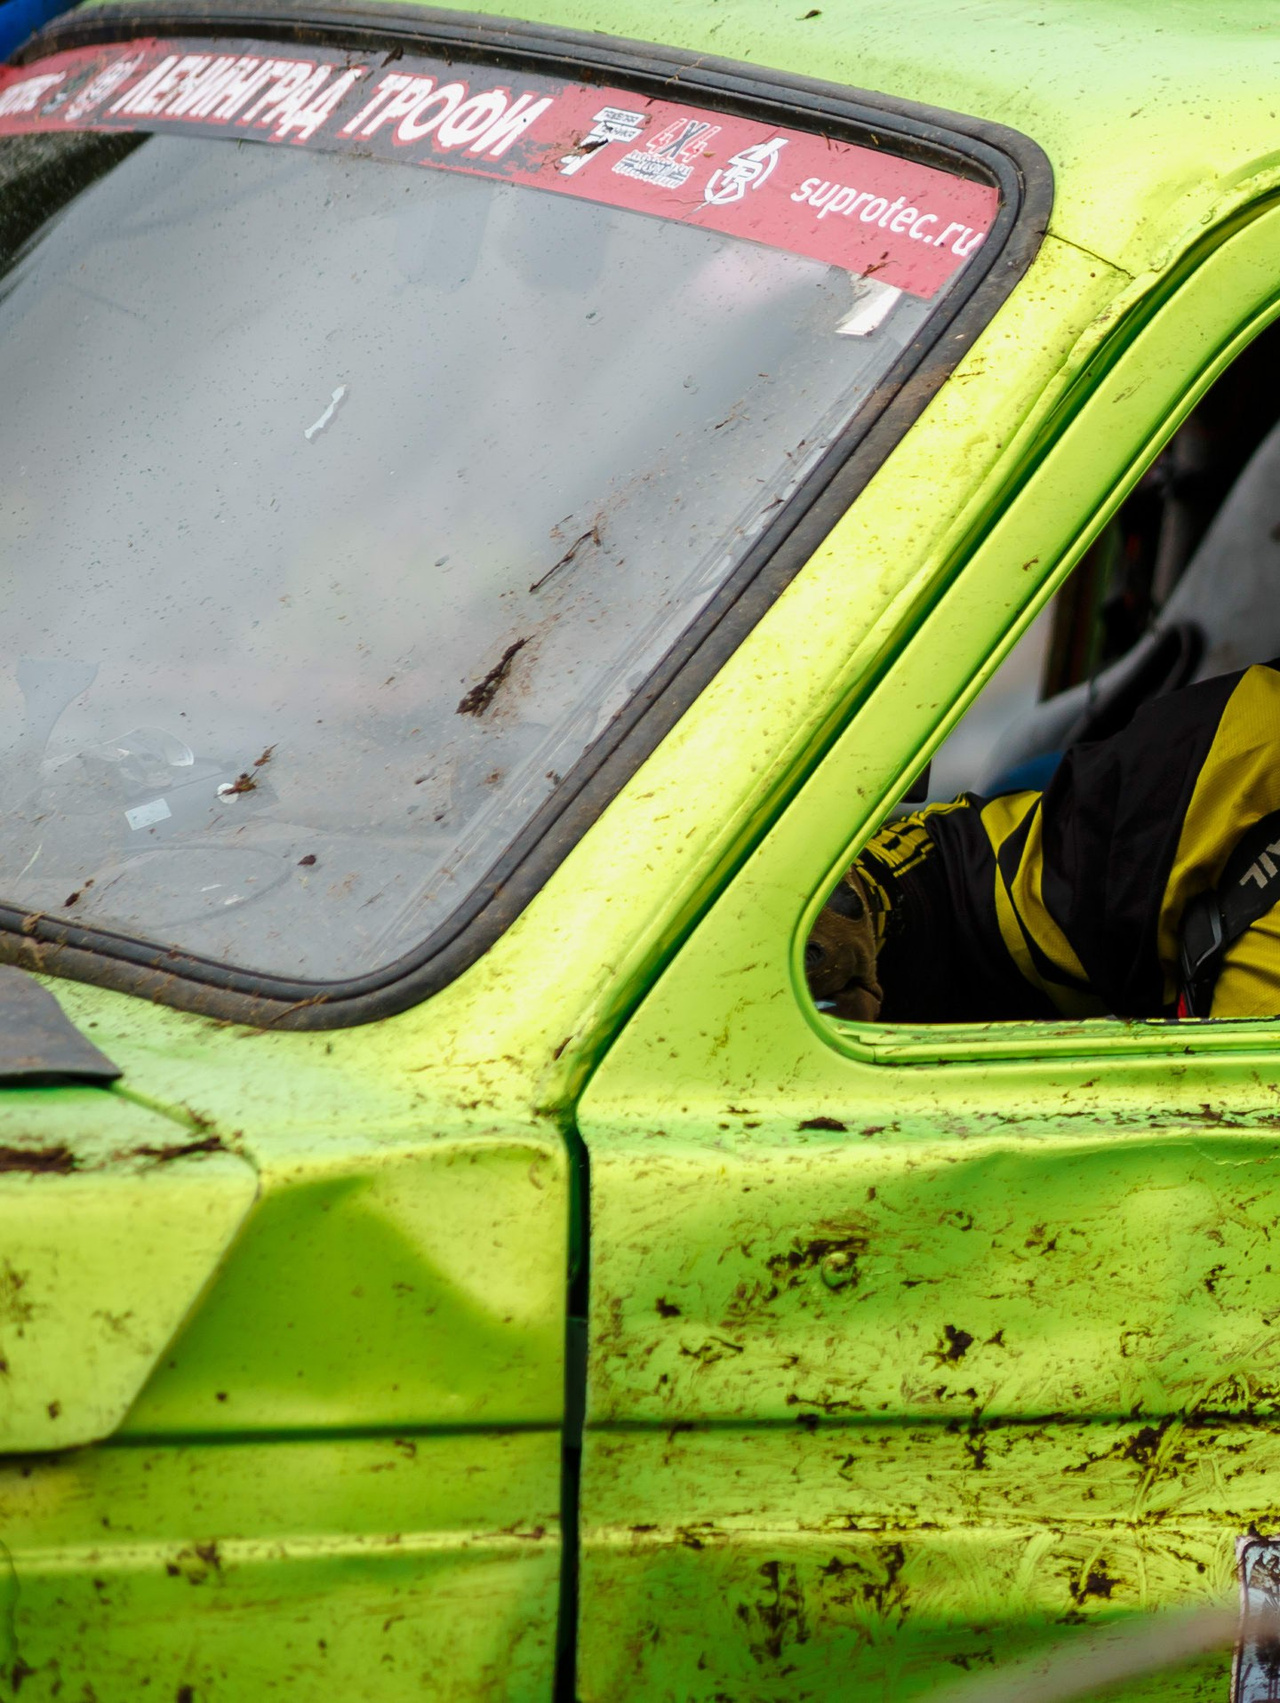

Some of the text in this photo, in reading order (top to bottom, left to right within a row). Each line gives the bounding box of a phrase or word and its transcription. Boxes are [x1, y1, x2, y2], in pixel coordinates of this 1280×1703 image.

[110, 55, 363, 141] ЛЕНИНГРАД
[343, 74, 555, 157] ТРОФИ
[790, 175, 984, 257] suprotec.ru
